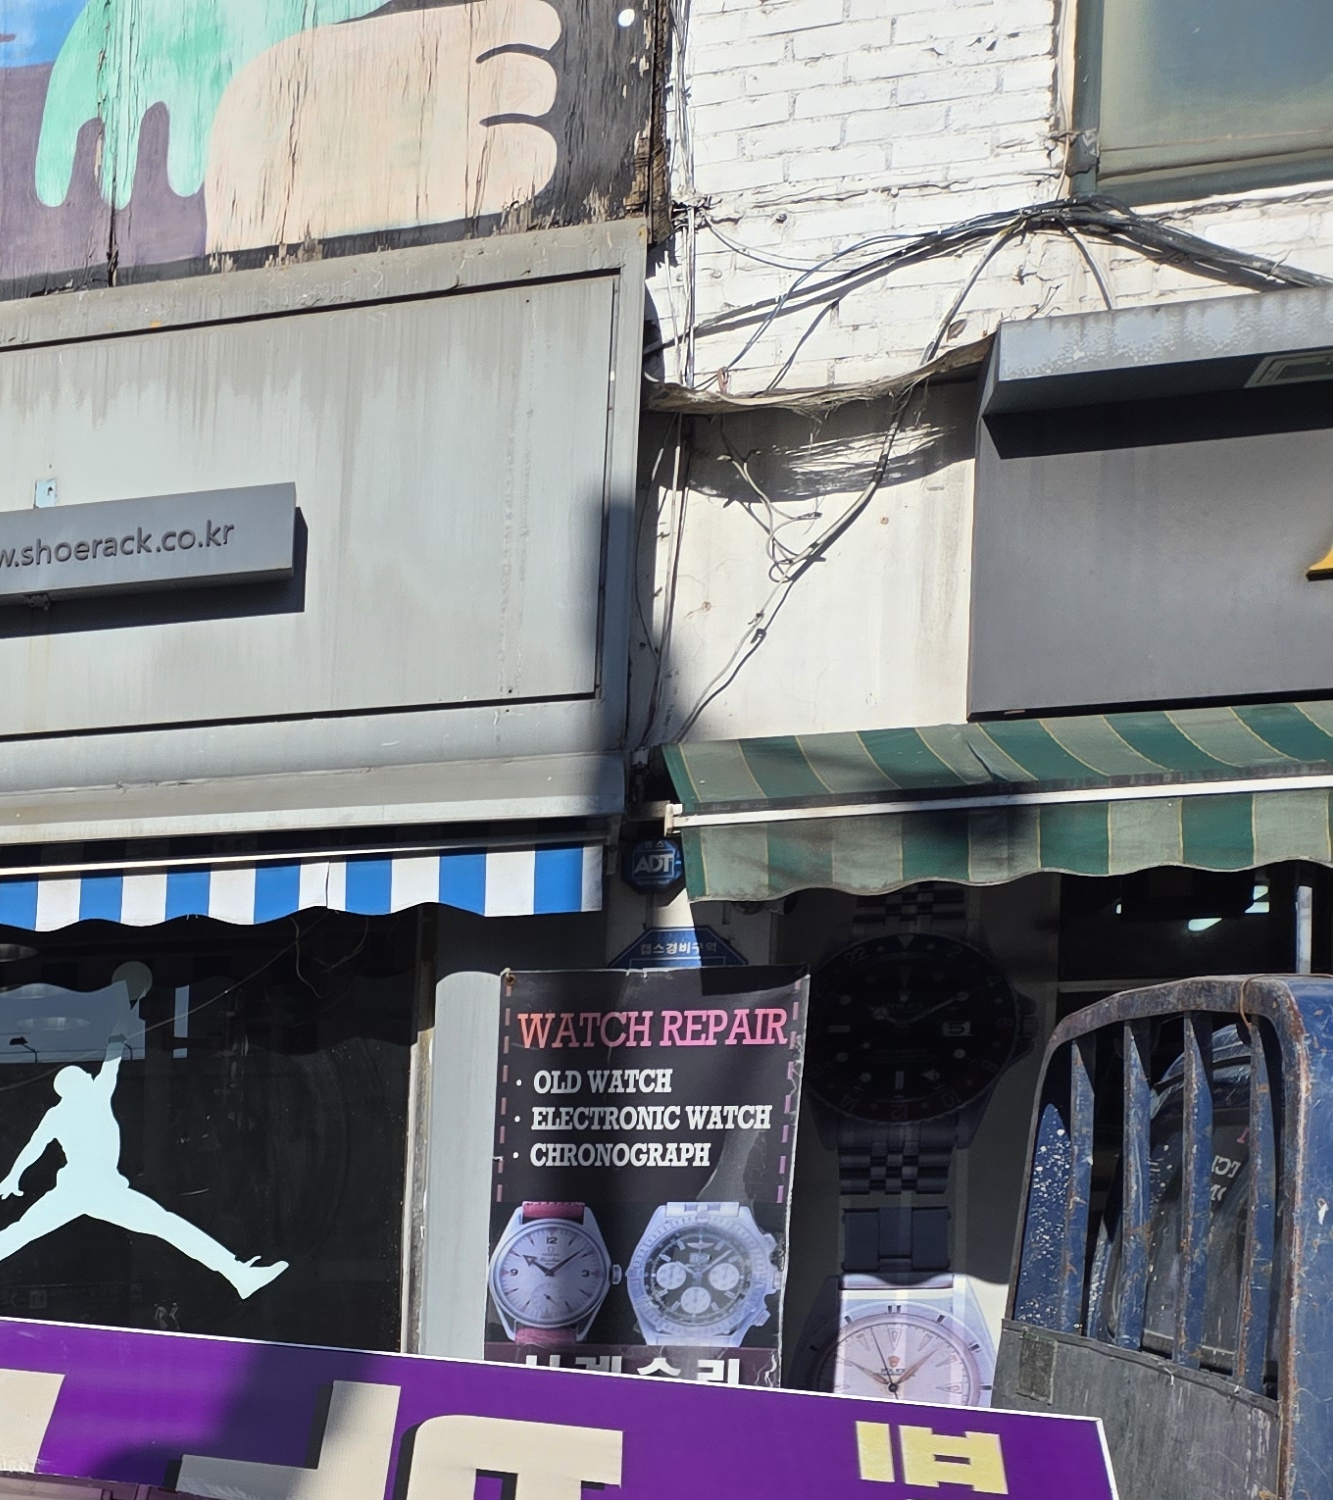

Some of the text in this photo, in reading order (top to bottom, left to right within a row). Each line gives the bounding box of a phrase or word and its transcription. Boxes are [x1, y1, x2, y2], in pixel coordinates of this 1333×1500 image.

[634, 854, 674, 874] ADT
[517, 1008, 788, 1048] WATCH REPAIR
[534, 1069, 673, 1094] OLD WATCH
[531, 1105, 772, 1130] ELECTRONIC WATCH
[530, 1143, 711, 1167] CHRONOGRAPH
